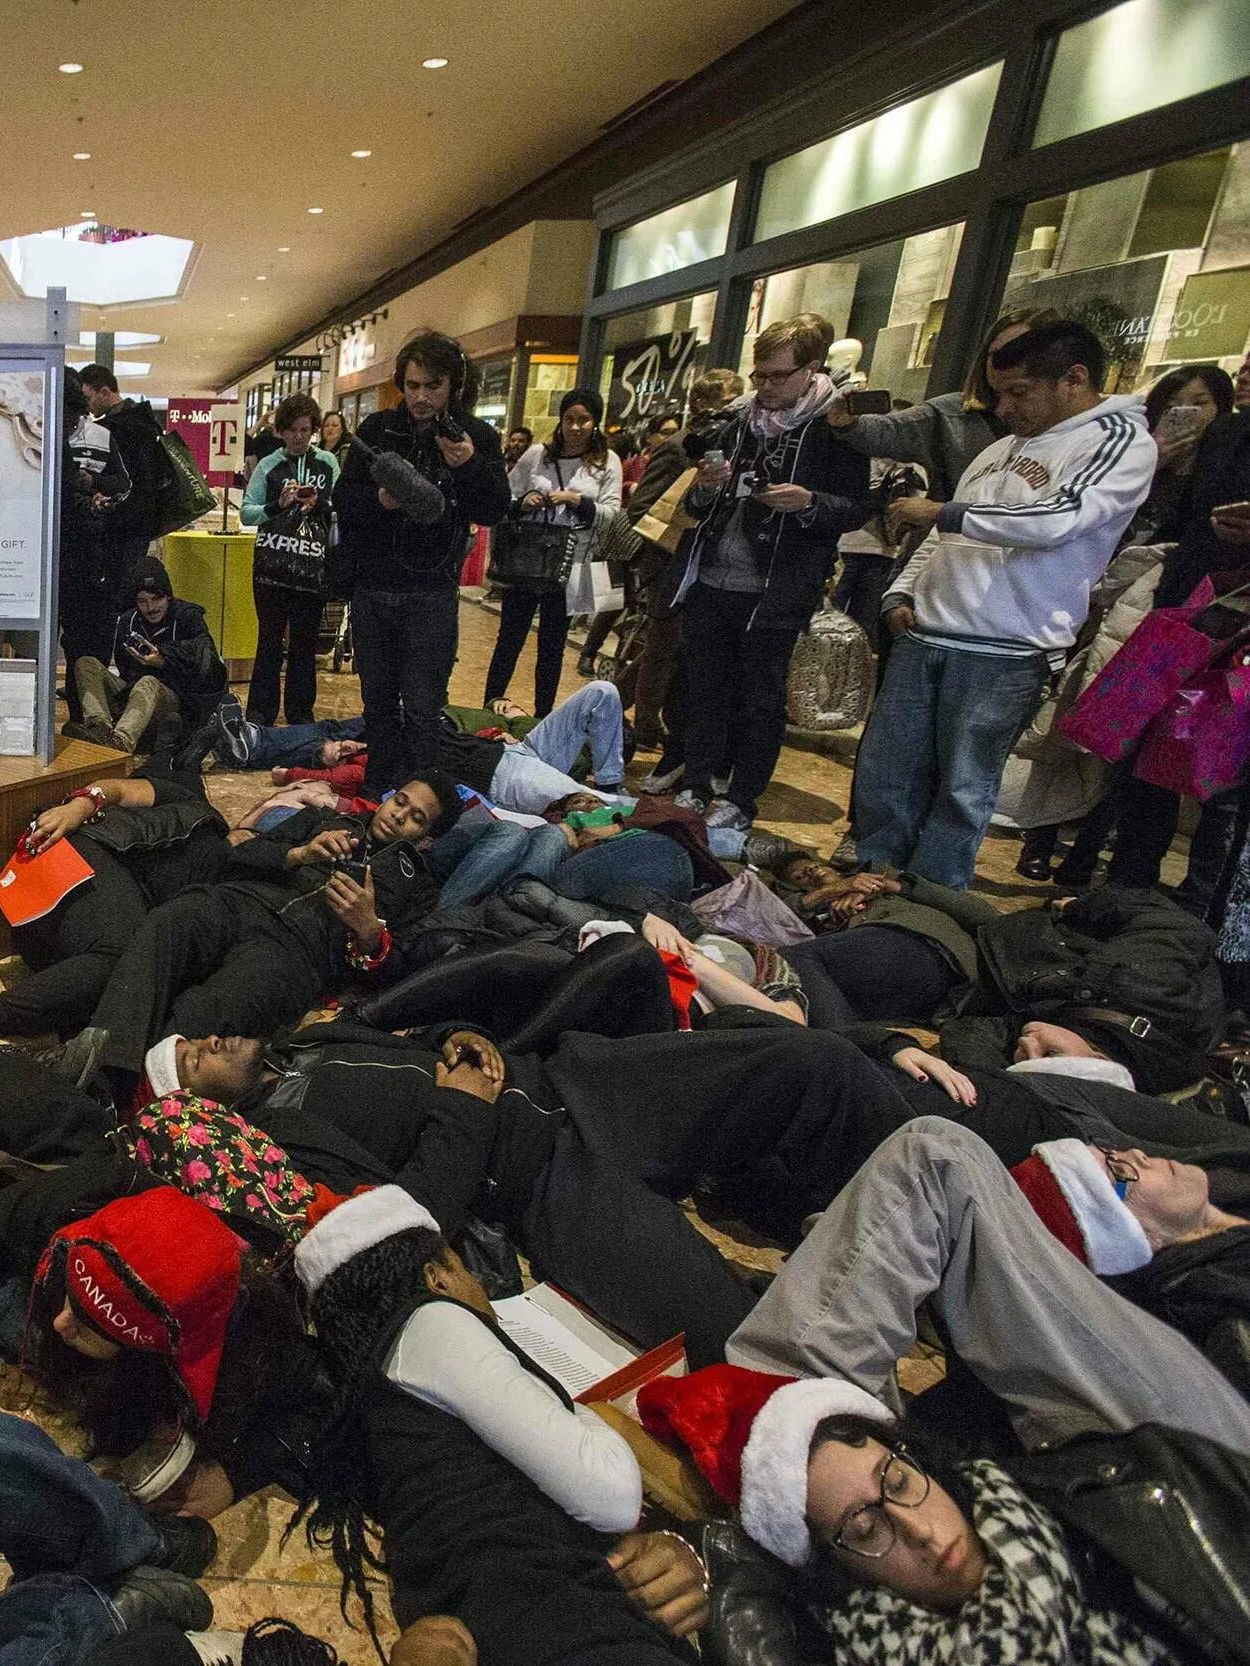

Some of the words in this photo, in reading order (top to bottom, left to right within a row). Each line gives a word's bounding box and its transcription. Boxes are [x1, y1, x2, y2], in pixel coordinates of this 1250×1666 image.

[278, 359, 302, 367] west
[303, 359, 320, 367] elm
[1, 540, 27, 549] GIFT.
[74, 1258, 139, 1340] CANADA
